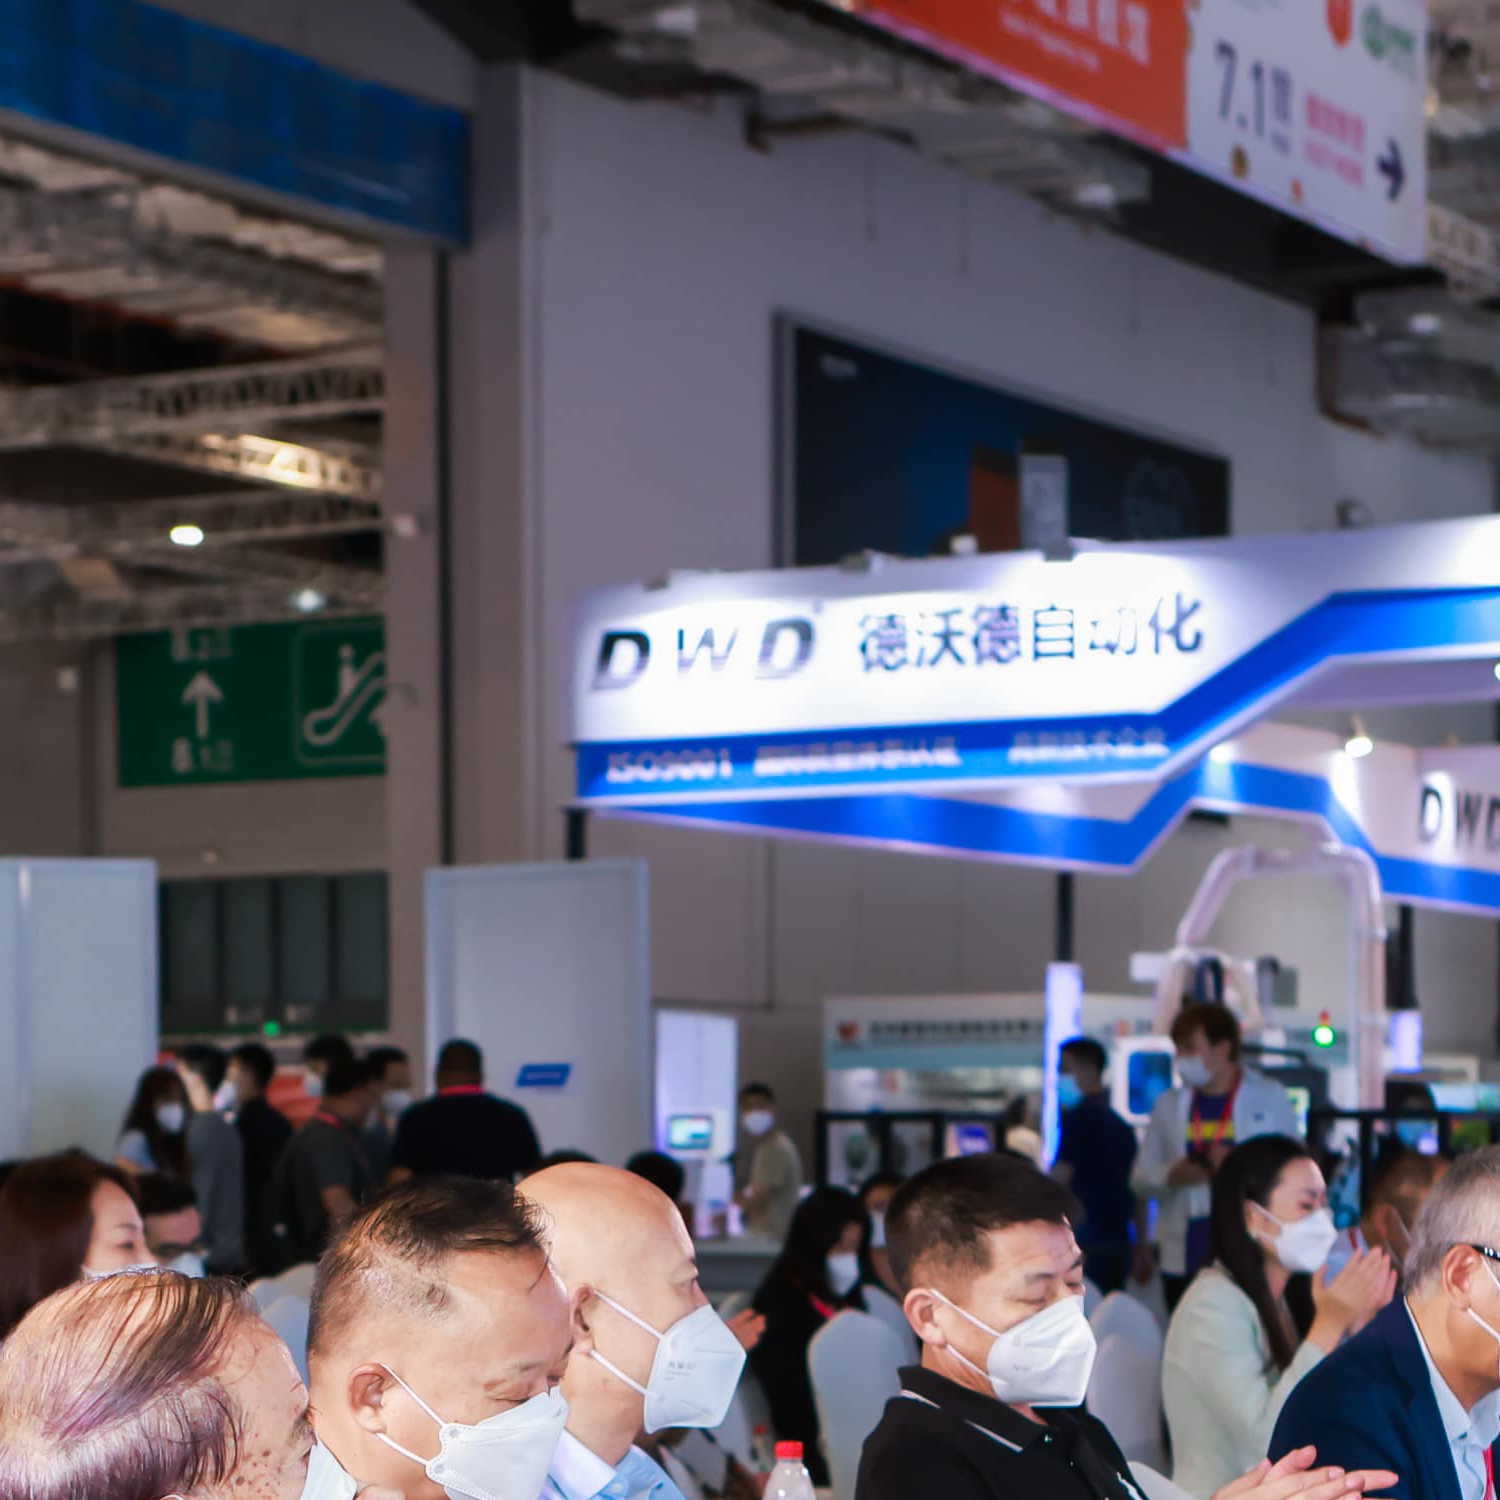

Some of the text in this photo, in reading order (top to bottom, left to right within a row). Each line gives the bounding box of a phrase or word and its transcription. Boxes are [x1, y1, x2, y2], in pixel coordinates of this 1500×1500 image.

[591, 593, 1205, 691] DWD 德沃德自动化
